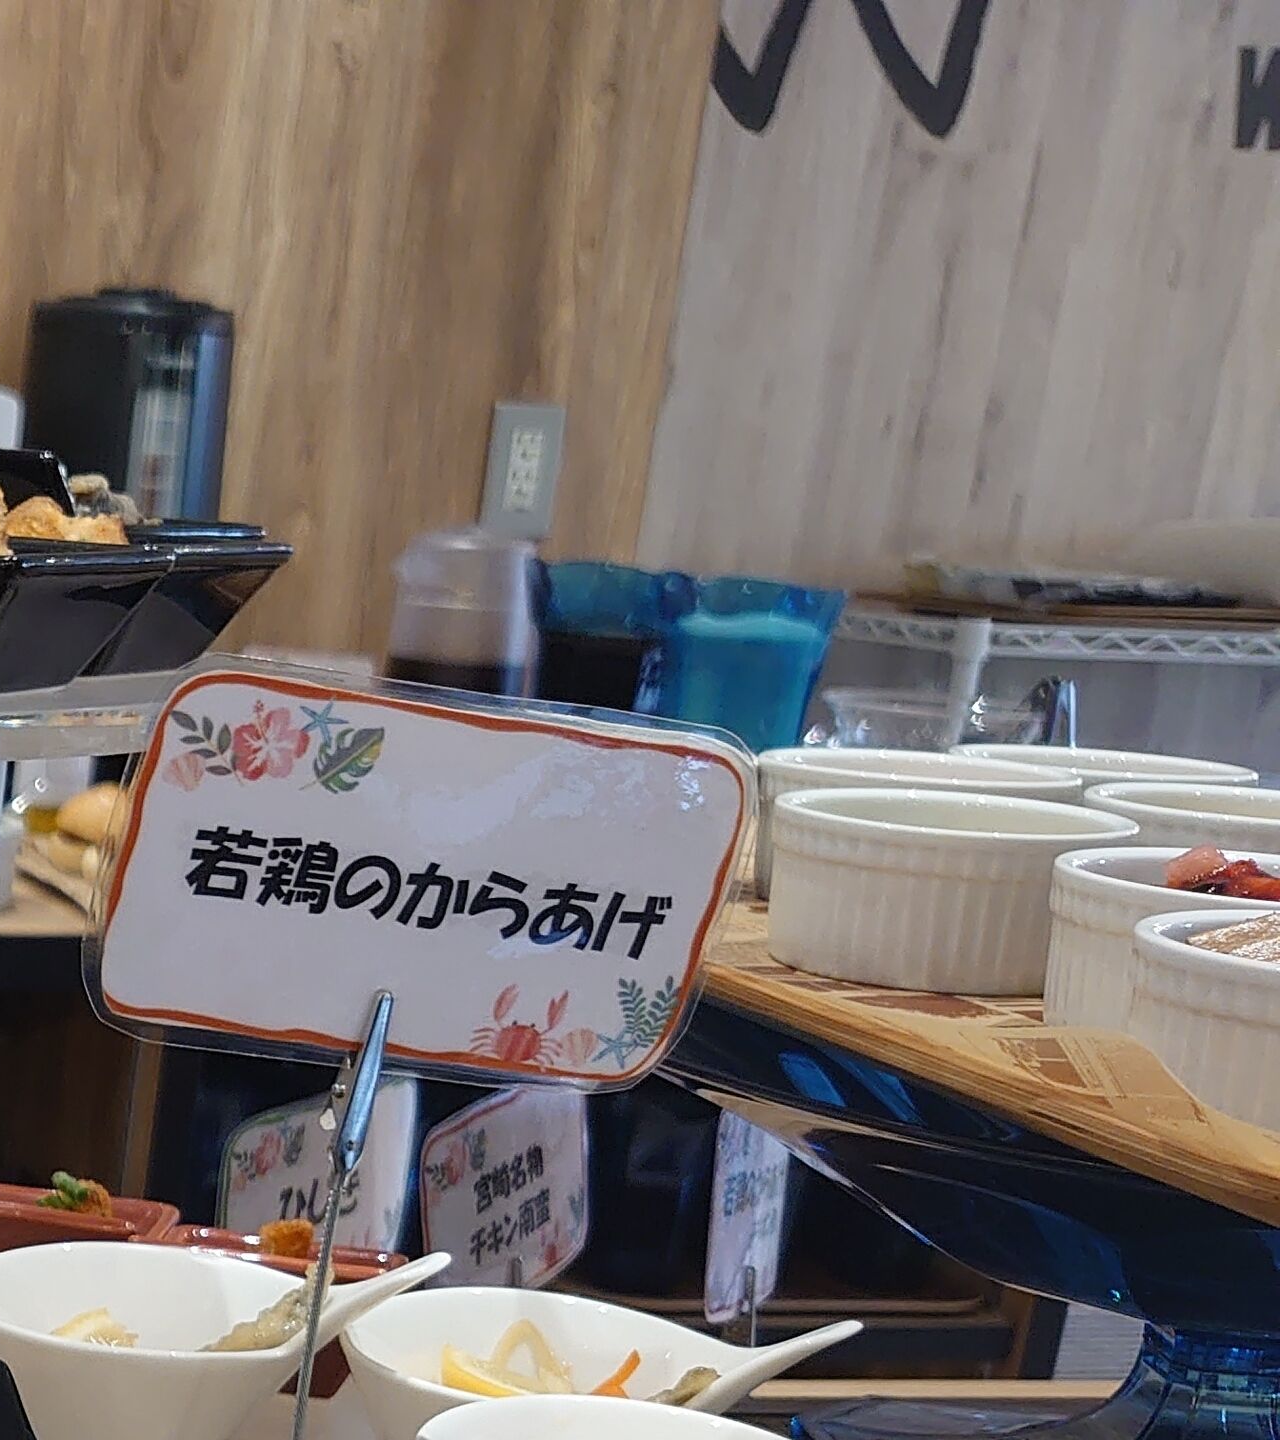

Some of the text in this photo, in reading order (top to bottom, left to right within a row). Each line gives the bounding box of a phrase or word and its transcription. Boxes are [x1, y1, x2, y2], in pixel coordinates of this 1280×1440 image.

[184, 825, 673, 960] 若鶏のからあげ
[473, 1142, 544, 1215] 宮崎名物
